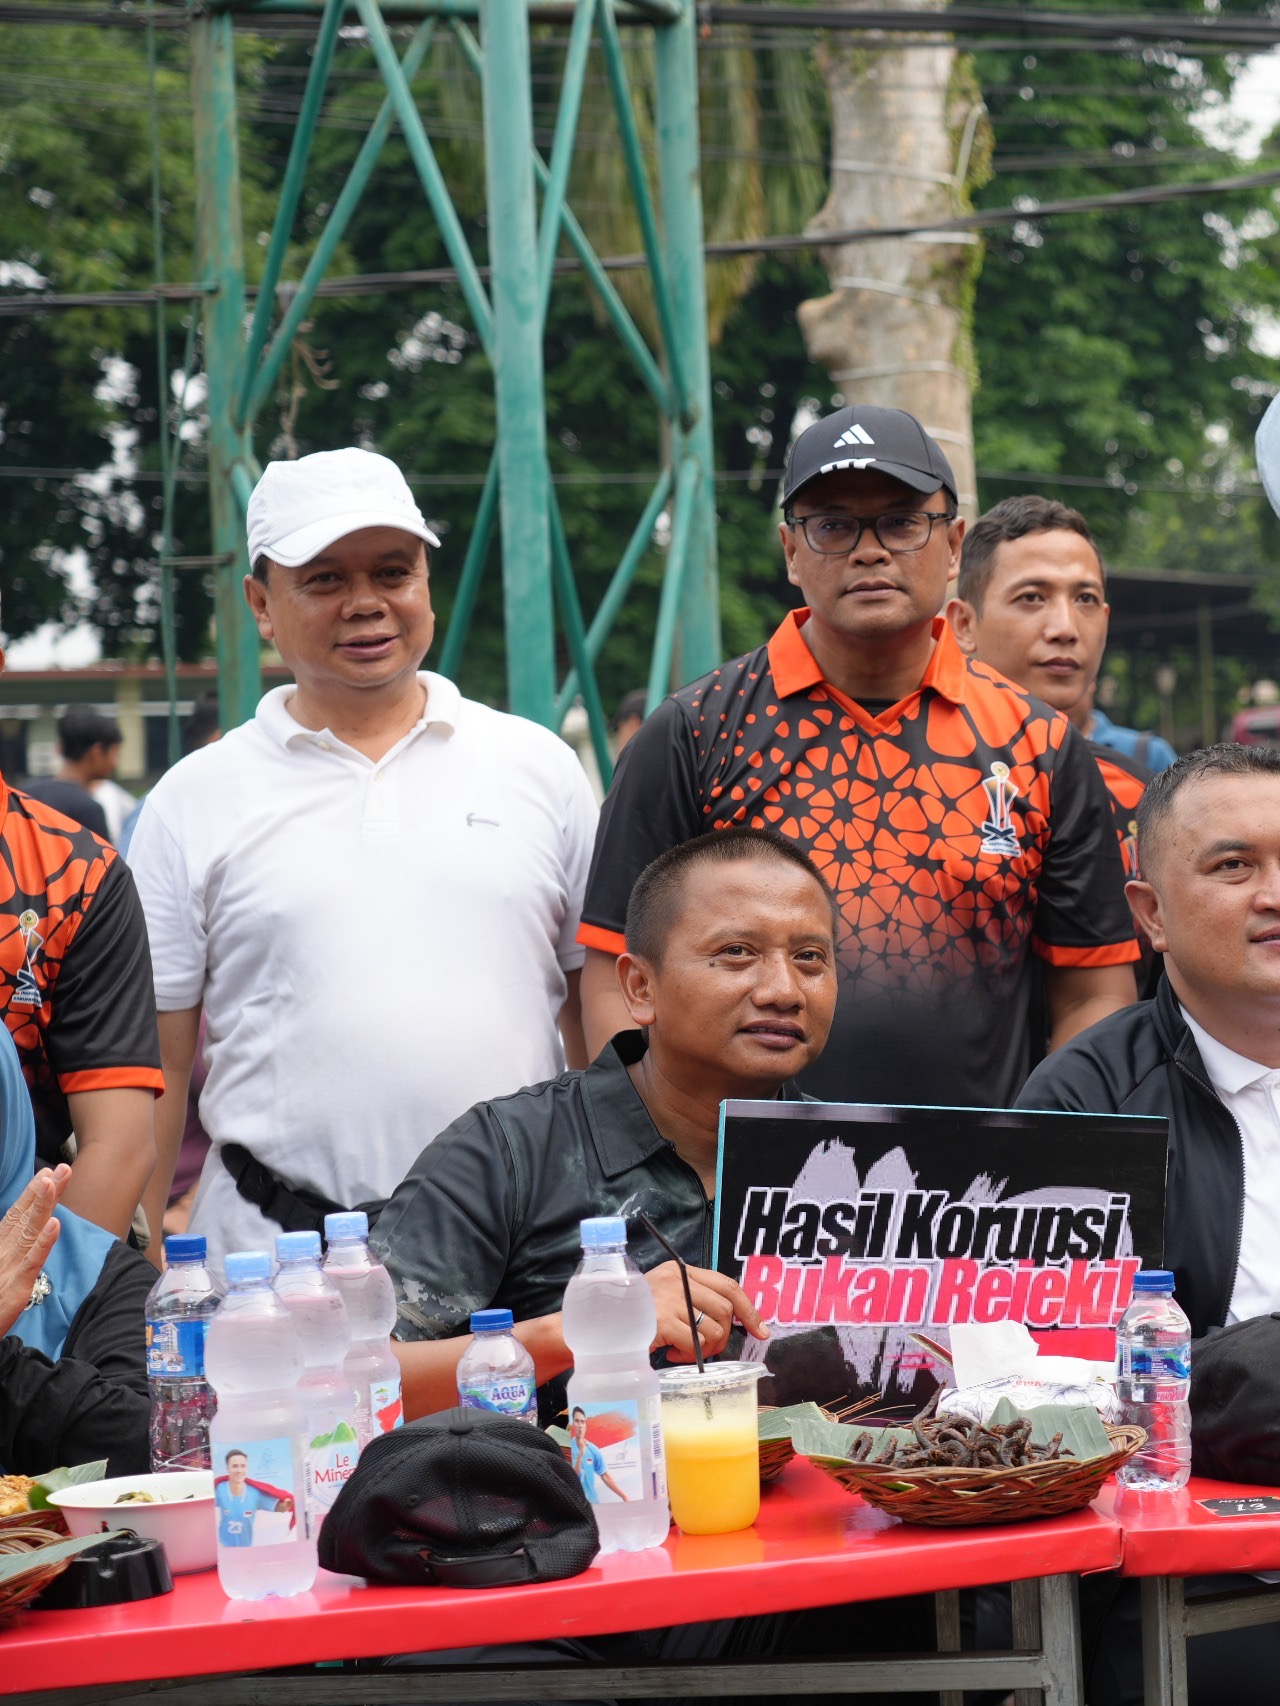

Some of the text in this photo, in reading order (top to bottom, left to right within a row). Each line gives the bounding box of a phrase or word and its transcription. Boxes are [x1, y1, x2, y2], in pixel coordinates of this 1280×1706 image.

[733, 1187, 1131, 1266] Hasil Korupsi
[735, 1254, 1142, 1329] Bukan Rejeki!
[491, 1384, 527, 1402] AQUA
[336, 1453, 349, 1468] Le
[227, 1520, 243, 1534] 23
